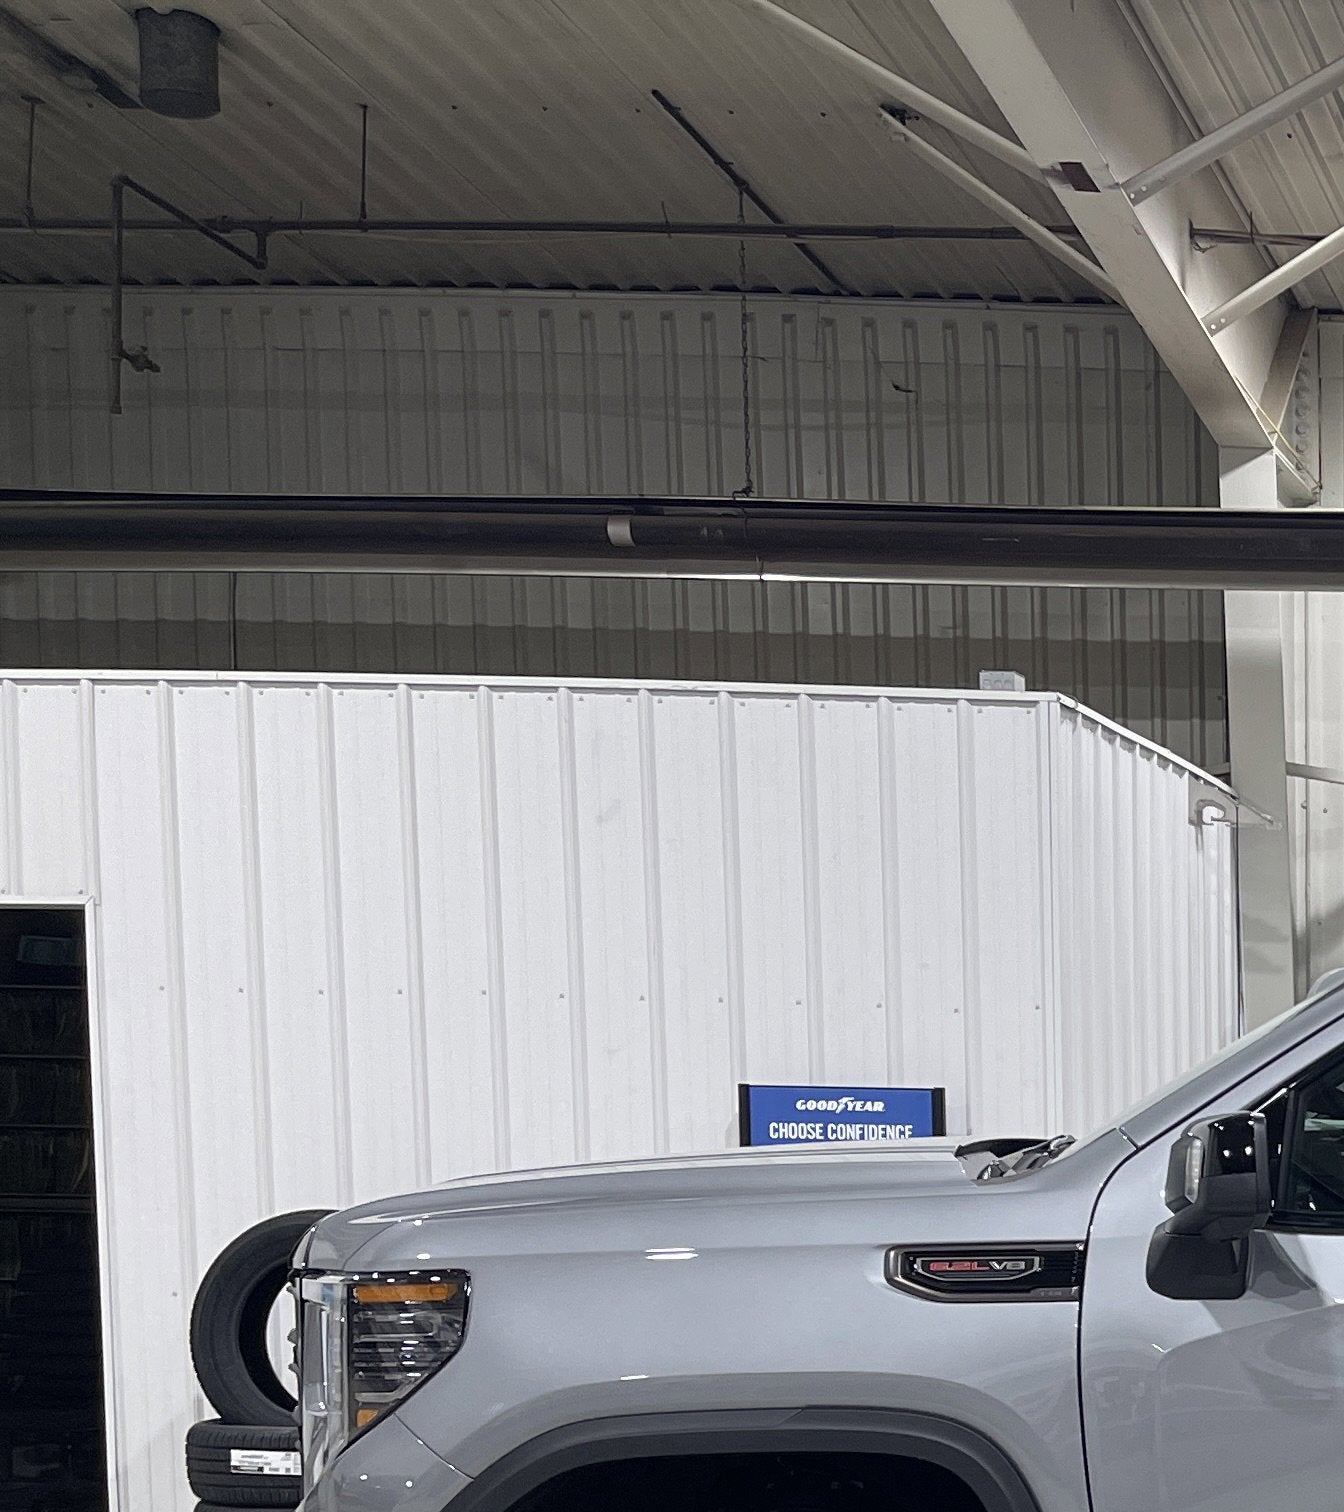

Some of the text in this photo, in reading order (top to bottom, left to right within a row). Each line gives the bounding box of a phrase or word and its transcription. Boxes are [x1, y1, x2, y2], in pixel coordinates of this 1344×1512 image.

[795, 1096, 885, 1114] GOODYEAR
[769, 1121, 914, 1141] CHOOSE CONFIDENCE
